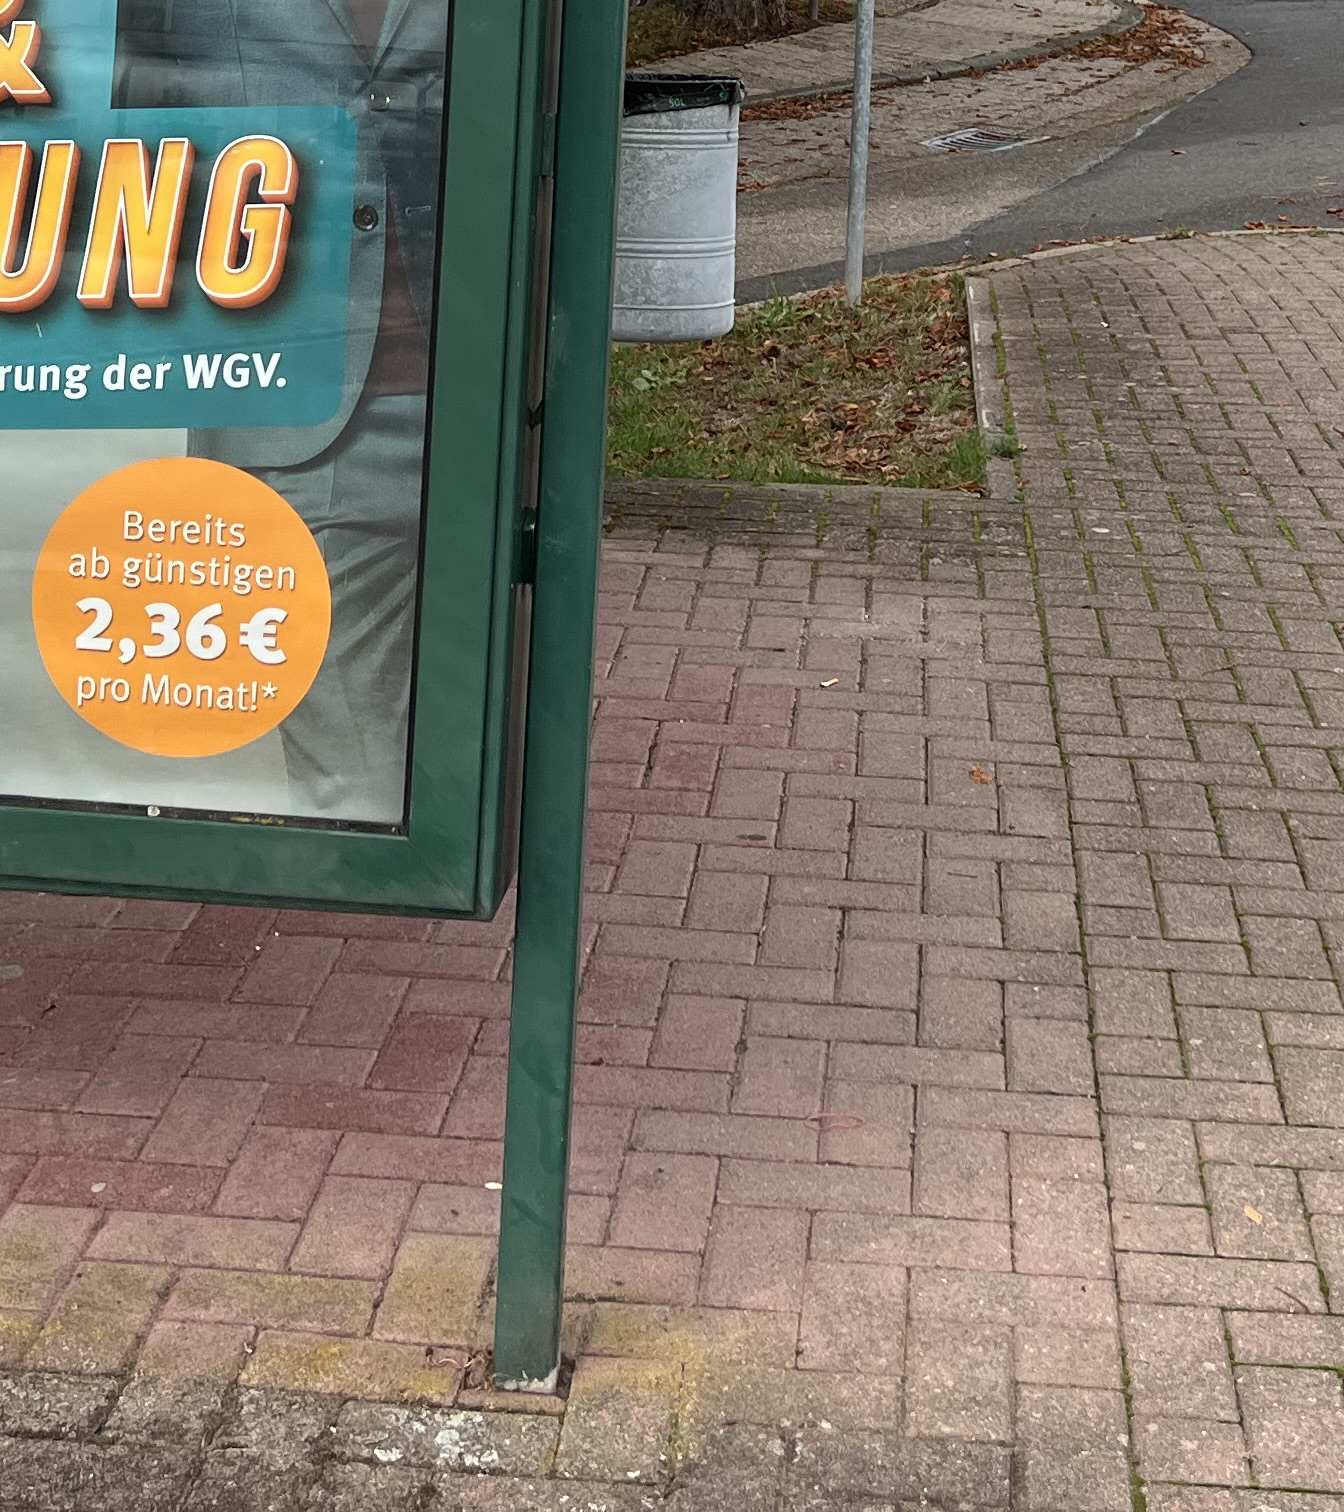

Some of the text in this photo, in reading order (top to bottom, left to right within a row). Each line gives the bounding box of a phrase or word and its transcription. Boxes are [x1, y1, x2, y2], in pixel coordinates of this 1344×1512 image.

[102, 353, 172, 391] der
[182, 352, 287, 390] WGV.
[122, 509, 246, 547] Bereits
[68, 546, 296, 595] ab günstigen
[74, 596, 288, 665] 2,36 €
[76, 674, 130, 706] pro
